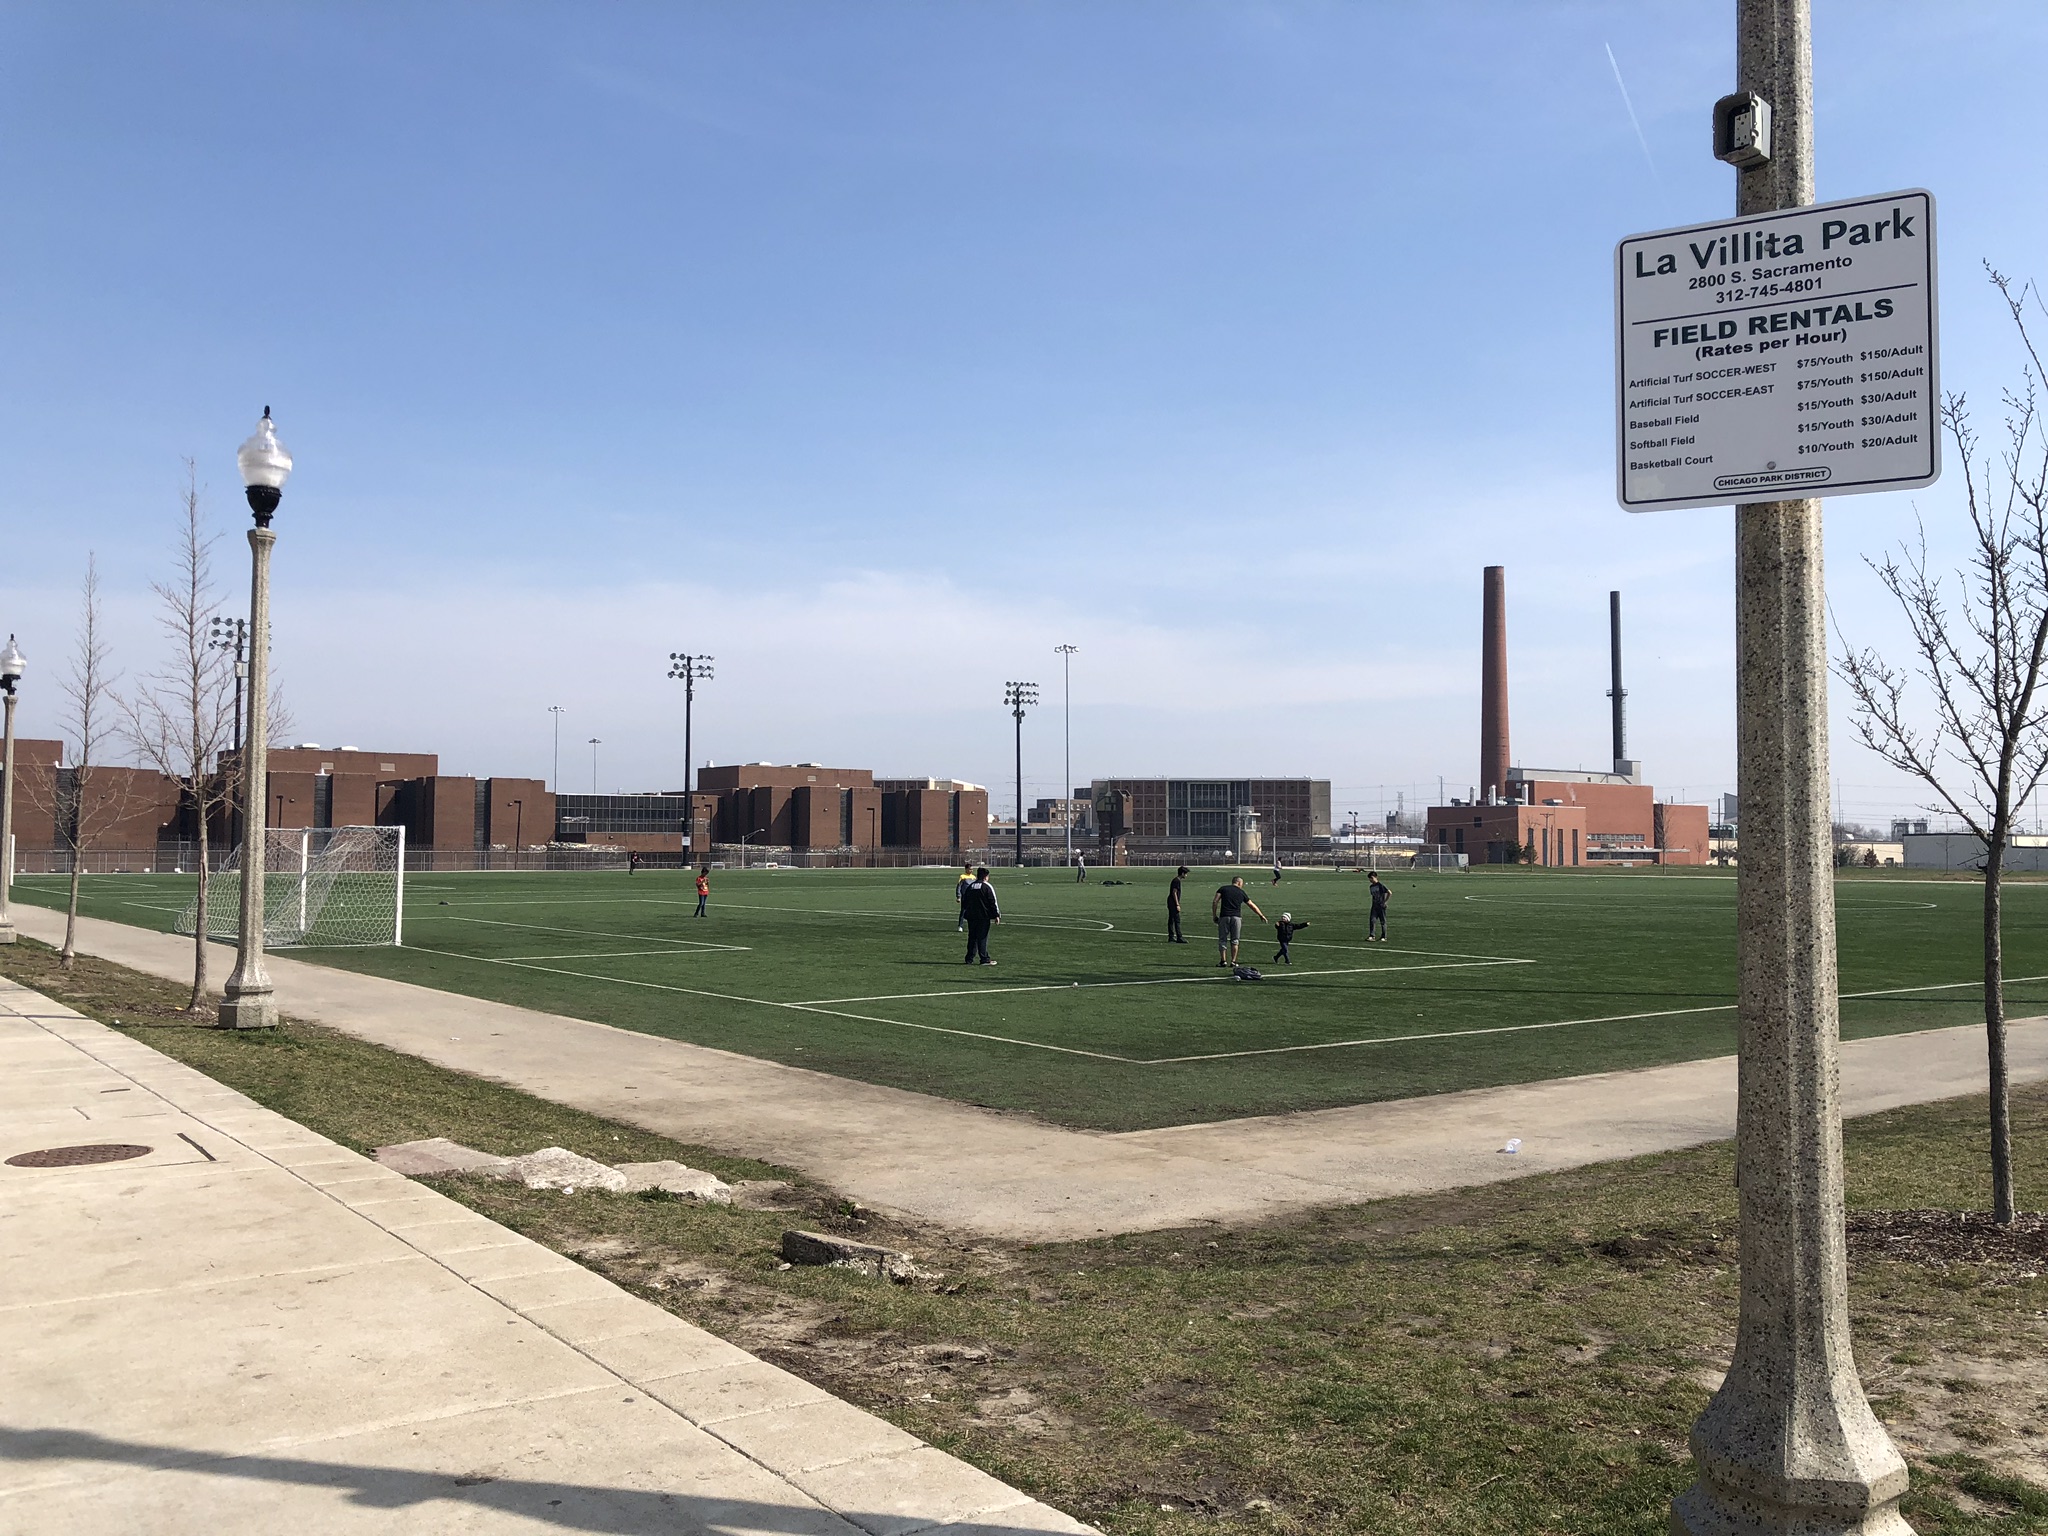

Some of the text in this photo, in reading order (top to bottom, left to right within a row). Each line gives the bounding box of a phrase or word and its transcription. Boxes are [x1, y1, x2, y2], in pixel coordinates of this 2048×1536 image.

[1636, 208, 1915, 278] La Villita Park
[1689, 255, 1852, 290] 2800 S. Sacramento
[1716, 277, 1822, 304] 312-745-4801
[1654, 298, 1894, 348] FIELD RENTALS
[1695, 328, 1847, 361] (Rates per Hour)
[1629, 344, 1923, 388] Artificial Turf SOCCER-WEST $75/Youth $150/Adult
[1629, 367, 1924, 409] Artificial Turf SOCCER-EAST $75/Youth $150/Adult
[1630, 389, 1917, 429] Baseball Field $15/Youth $30/Adult
[1630, 412, 1917, 450] Softball Field $15/Youth $30/Adult
[1630, 434, 1918, 470] Basketball Court $10/Youth $20/Adult
[1718, 470, 1826, 487] CHICAGO PARK DISTRICT
